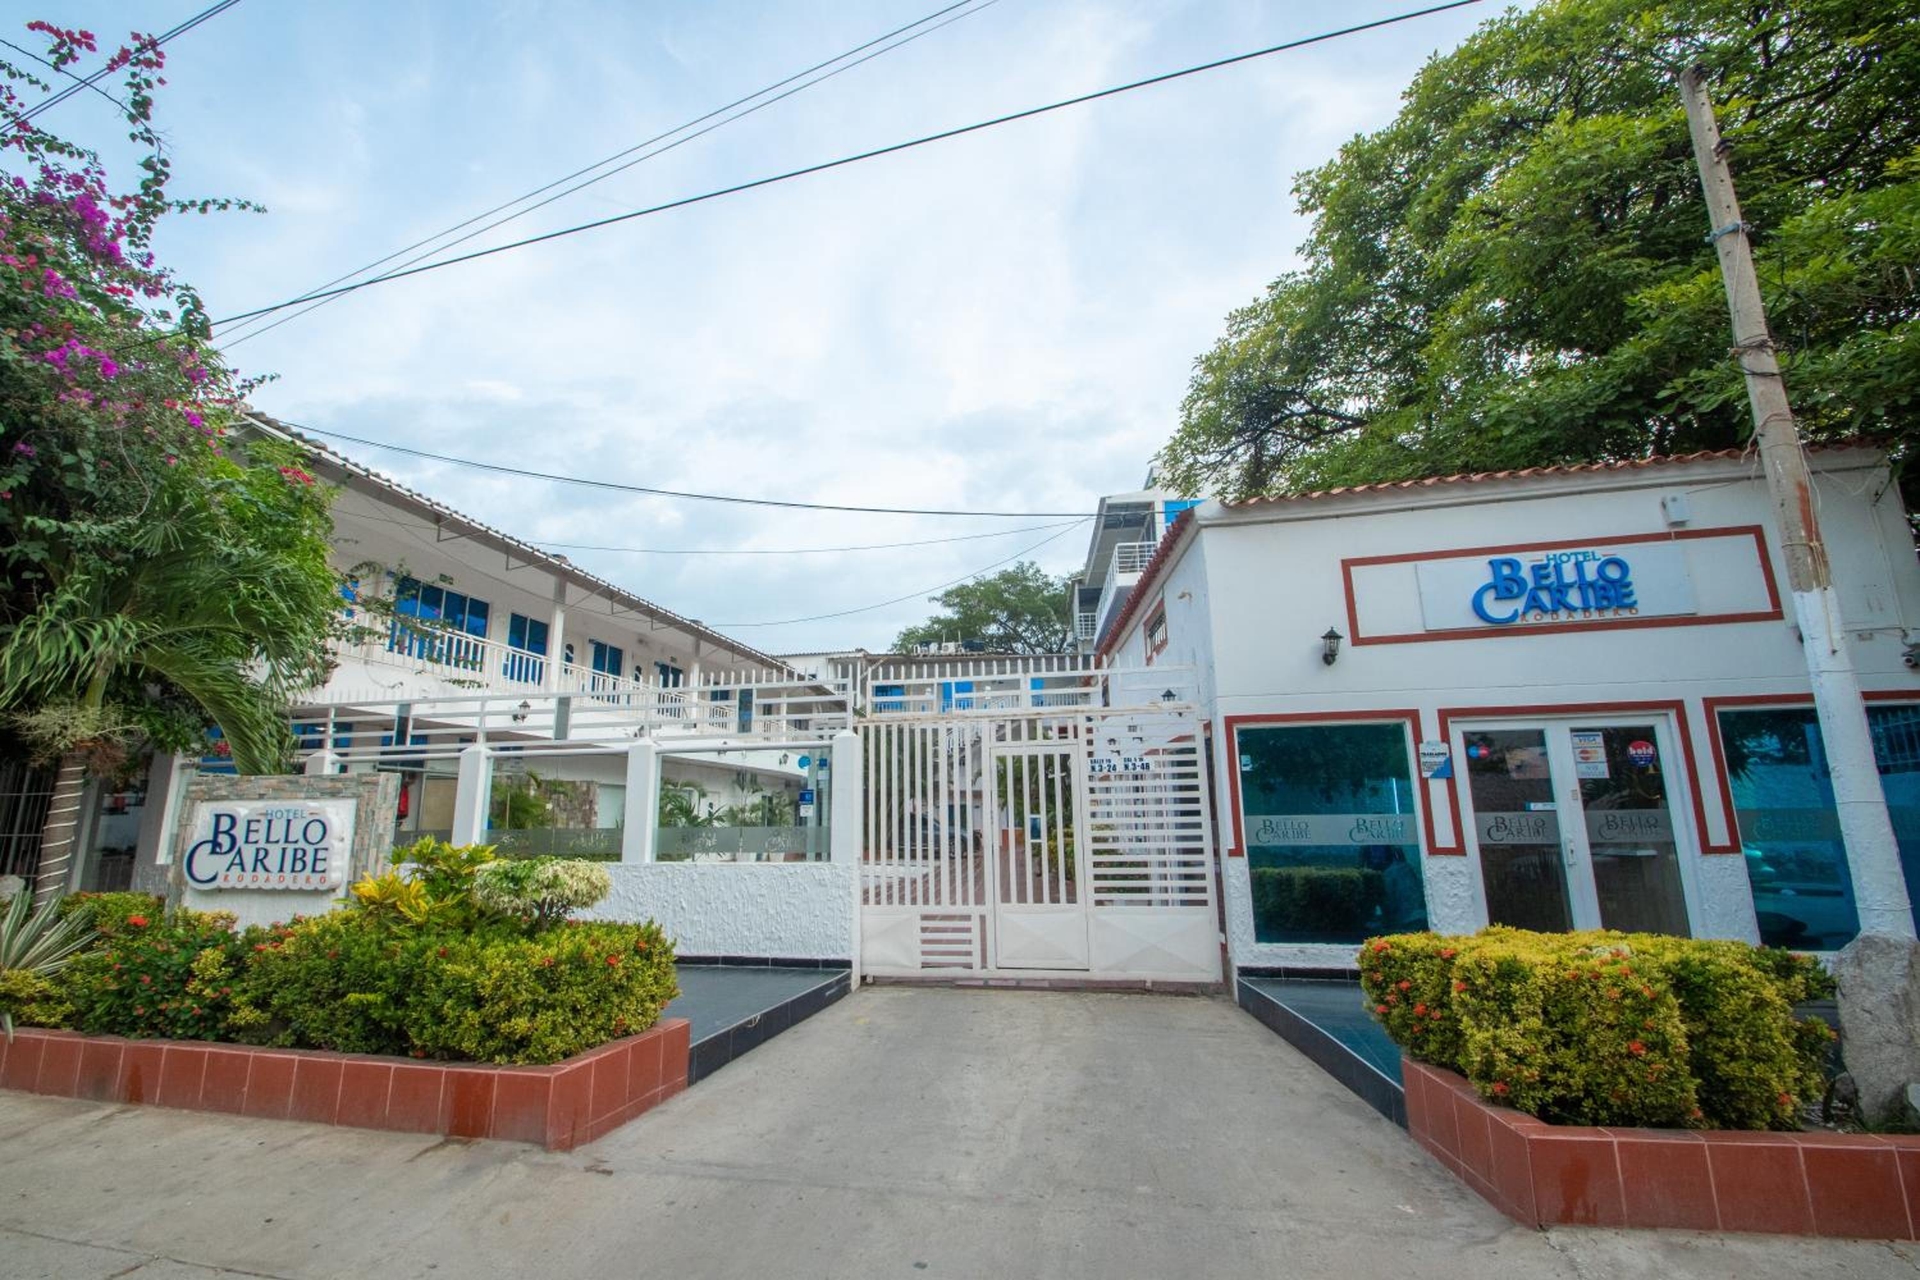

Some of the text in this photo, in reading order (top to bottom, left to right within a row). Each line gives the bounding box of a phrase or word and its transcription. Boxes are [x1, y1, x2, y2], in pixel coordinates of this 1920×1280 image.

[1546, 551, 1601, 564] HOTEL
[1488, 557, 1630, 600] BELLO
[1472, 581, 1638, 624] CARIBE
[1520, 608, 1639, 622] RODADERO
[266, 809, 307, 820] HOTEL
[1262, 819, 1309, 834] BELLO
[1495, 816, 1545, 832] BELLO
[209, 813, 327, 855] BELLO
[1256, 827, 1311, 843] CARIBE
[186, 839, 329, 884] CARIBE
[222, 874, 327, 885] RODADERO
